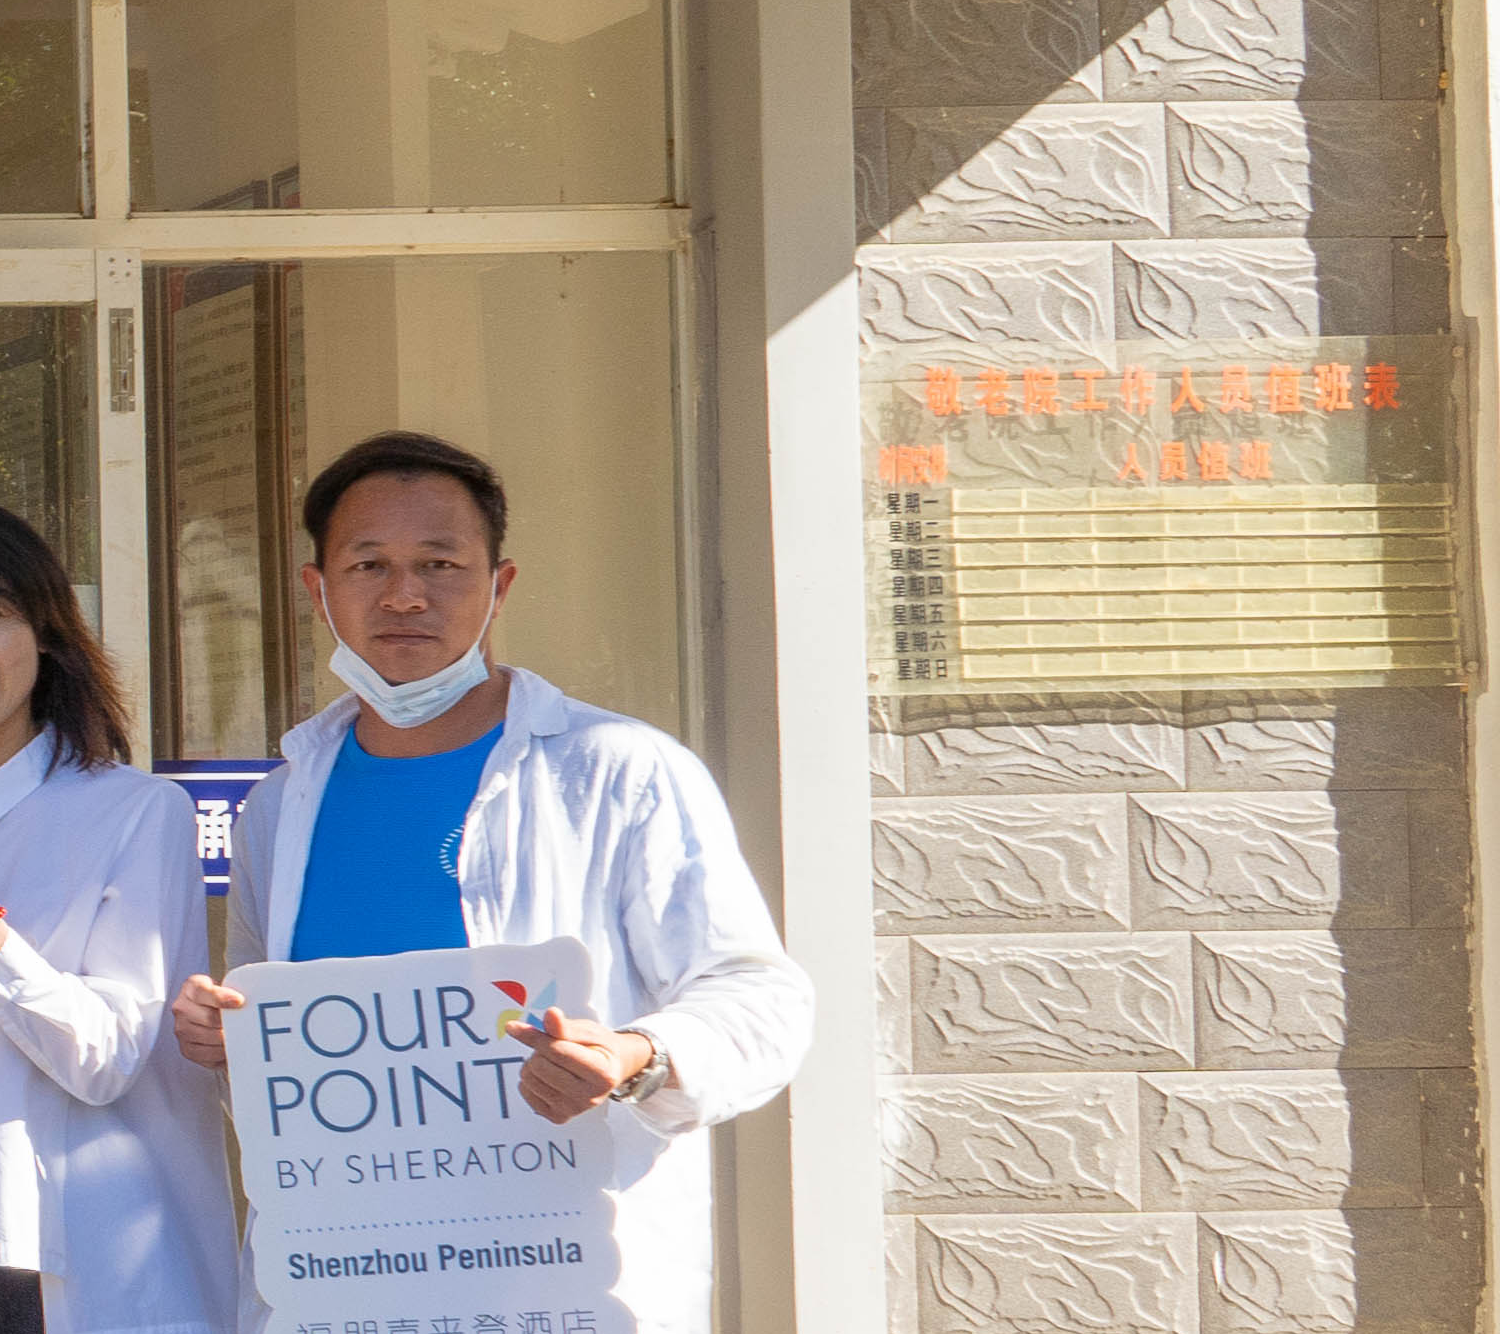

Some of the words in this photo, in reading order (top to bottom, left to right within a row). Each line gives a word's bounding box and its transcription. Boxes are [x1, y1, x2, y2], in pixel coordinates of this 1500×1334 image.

[925, 362, 1400, 416] 敬老院工作人员值班表
[1117, 441, 1275, 481] 人员值班
[257, 985, 489, 1063] FOUR
[266, 1055, 525, 1137] POINT
[276, 1157, 323, 1190] BY
[347, 1139, 577, 1185] SHERATON
[288, 1244, 428, 1280] Shenzhou
[437, 1237, 583, 1271] Peninsula
